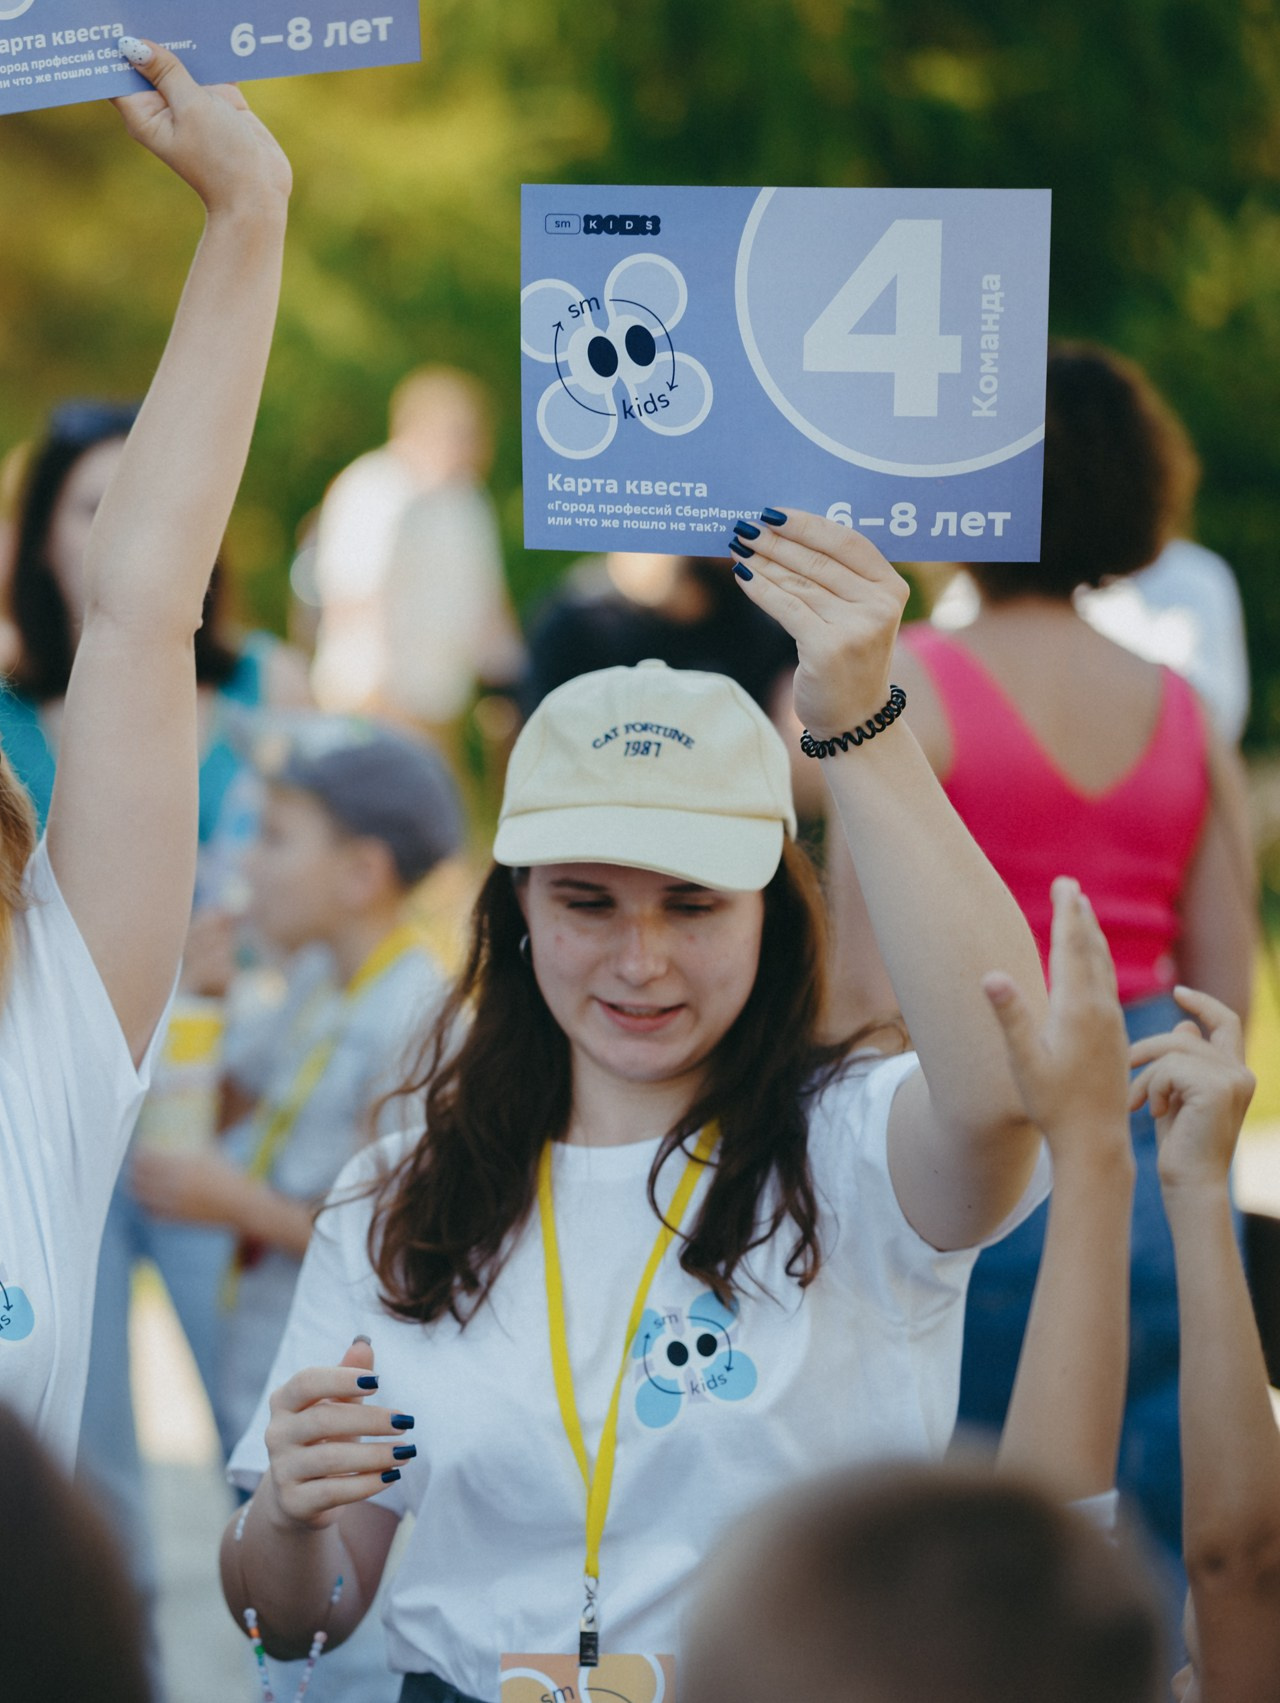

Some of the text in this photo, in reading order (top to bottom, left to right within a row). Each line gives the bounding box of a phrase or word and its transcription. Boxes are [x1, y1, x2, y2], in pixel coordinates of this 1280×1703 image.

[51, 22, 124, 47] квеста
[323, 16, 394, 48] лет
[31, 50, 95, 70] профессий
[12, 76, 33, 87] что
[35, 73, 52, 84] же
[54, 67, 92, 81] пошло
[94, 65, 109, 75] не
[554, 218, 655, 232] sm KIDS
[568, 296, 600, 319] sm
[803, 219, 962, 417] 4
[972, 274, 1005, 417] Команда
[622, 392, 670, 420] kids
[547, 472, 708, 497] Карта квеста
[547, 500, 763, 521] «Город профессий СберМаркет
[547, 516, 727, 533] или что же пошло не так?»
[930, 511, 1011, 537] лет
[592, 722, 695, 750] CAT FORTUNE
[624, 740, 662, 758] 1987
[653, 1313, 678, 1329] sm
[690, 1373, 728, 1396] kids
